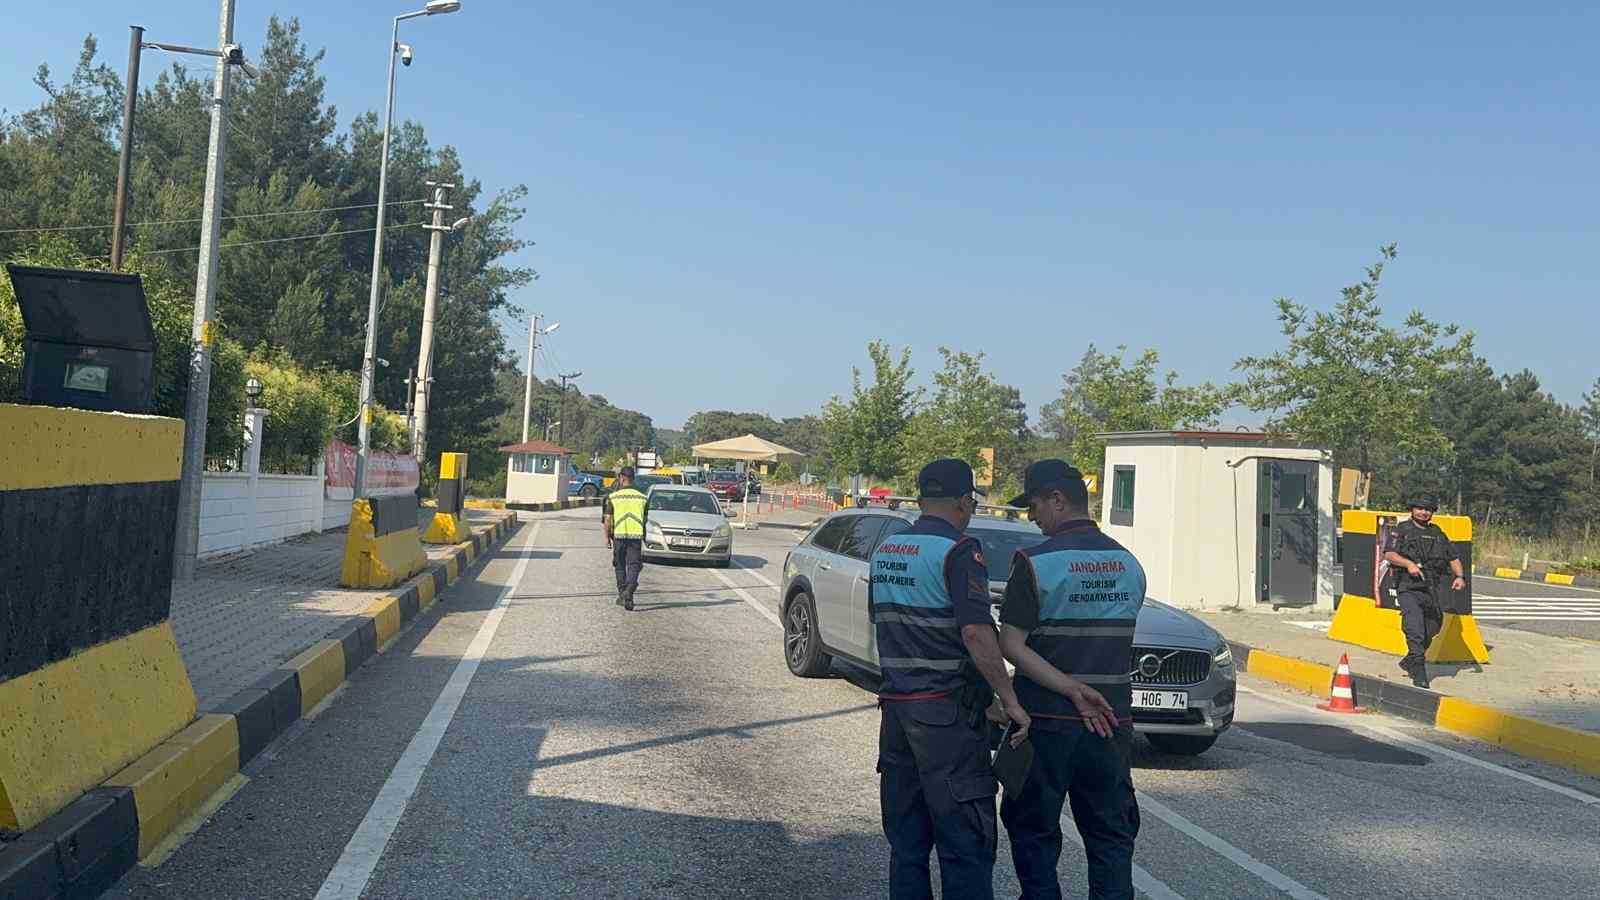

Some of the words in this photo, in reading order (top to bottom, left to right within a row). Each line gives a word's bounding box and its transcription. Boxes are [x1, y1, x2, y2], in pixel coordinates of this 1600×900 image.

[876, 560, 908, 571] TOURISM
[1068, 560, 1126, 573] JANDARMA
[1080, 579, 1116, 589] TOURISM
[1068, 591, 1129, 602] GENDARMERIE
[1141, 692, 1162, 706] HOG
[1172, 693, 1185, 707] 74
